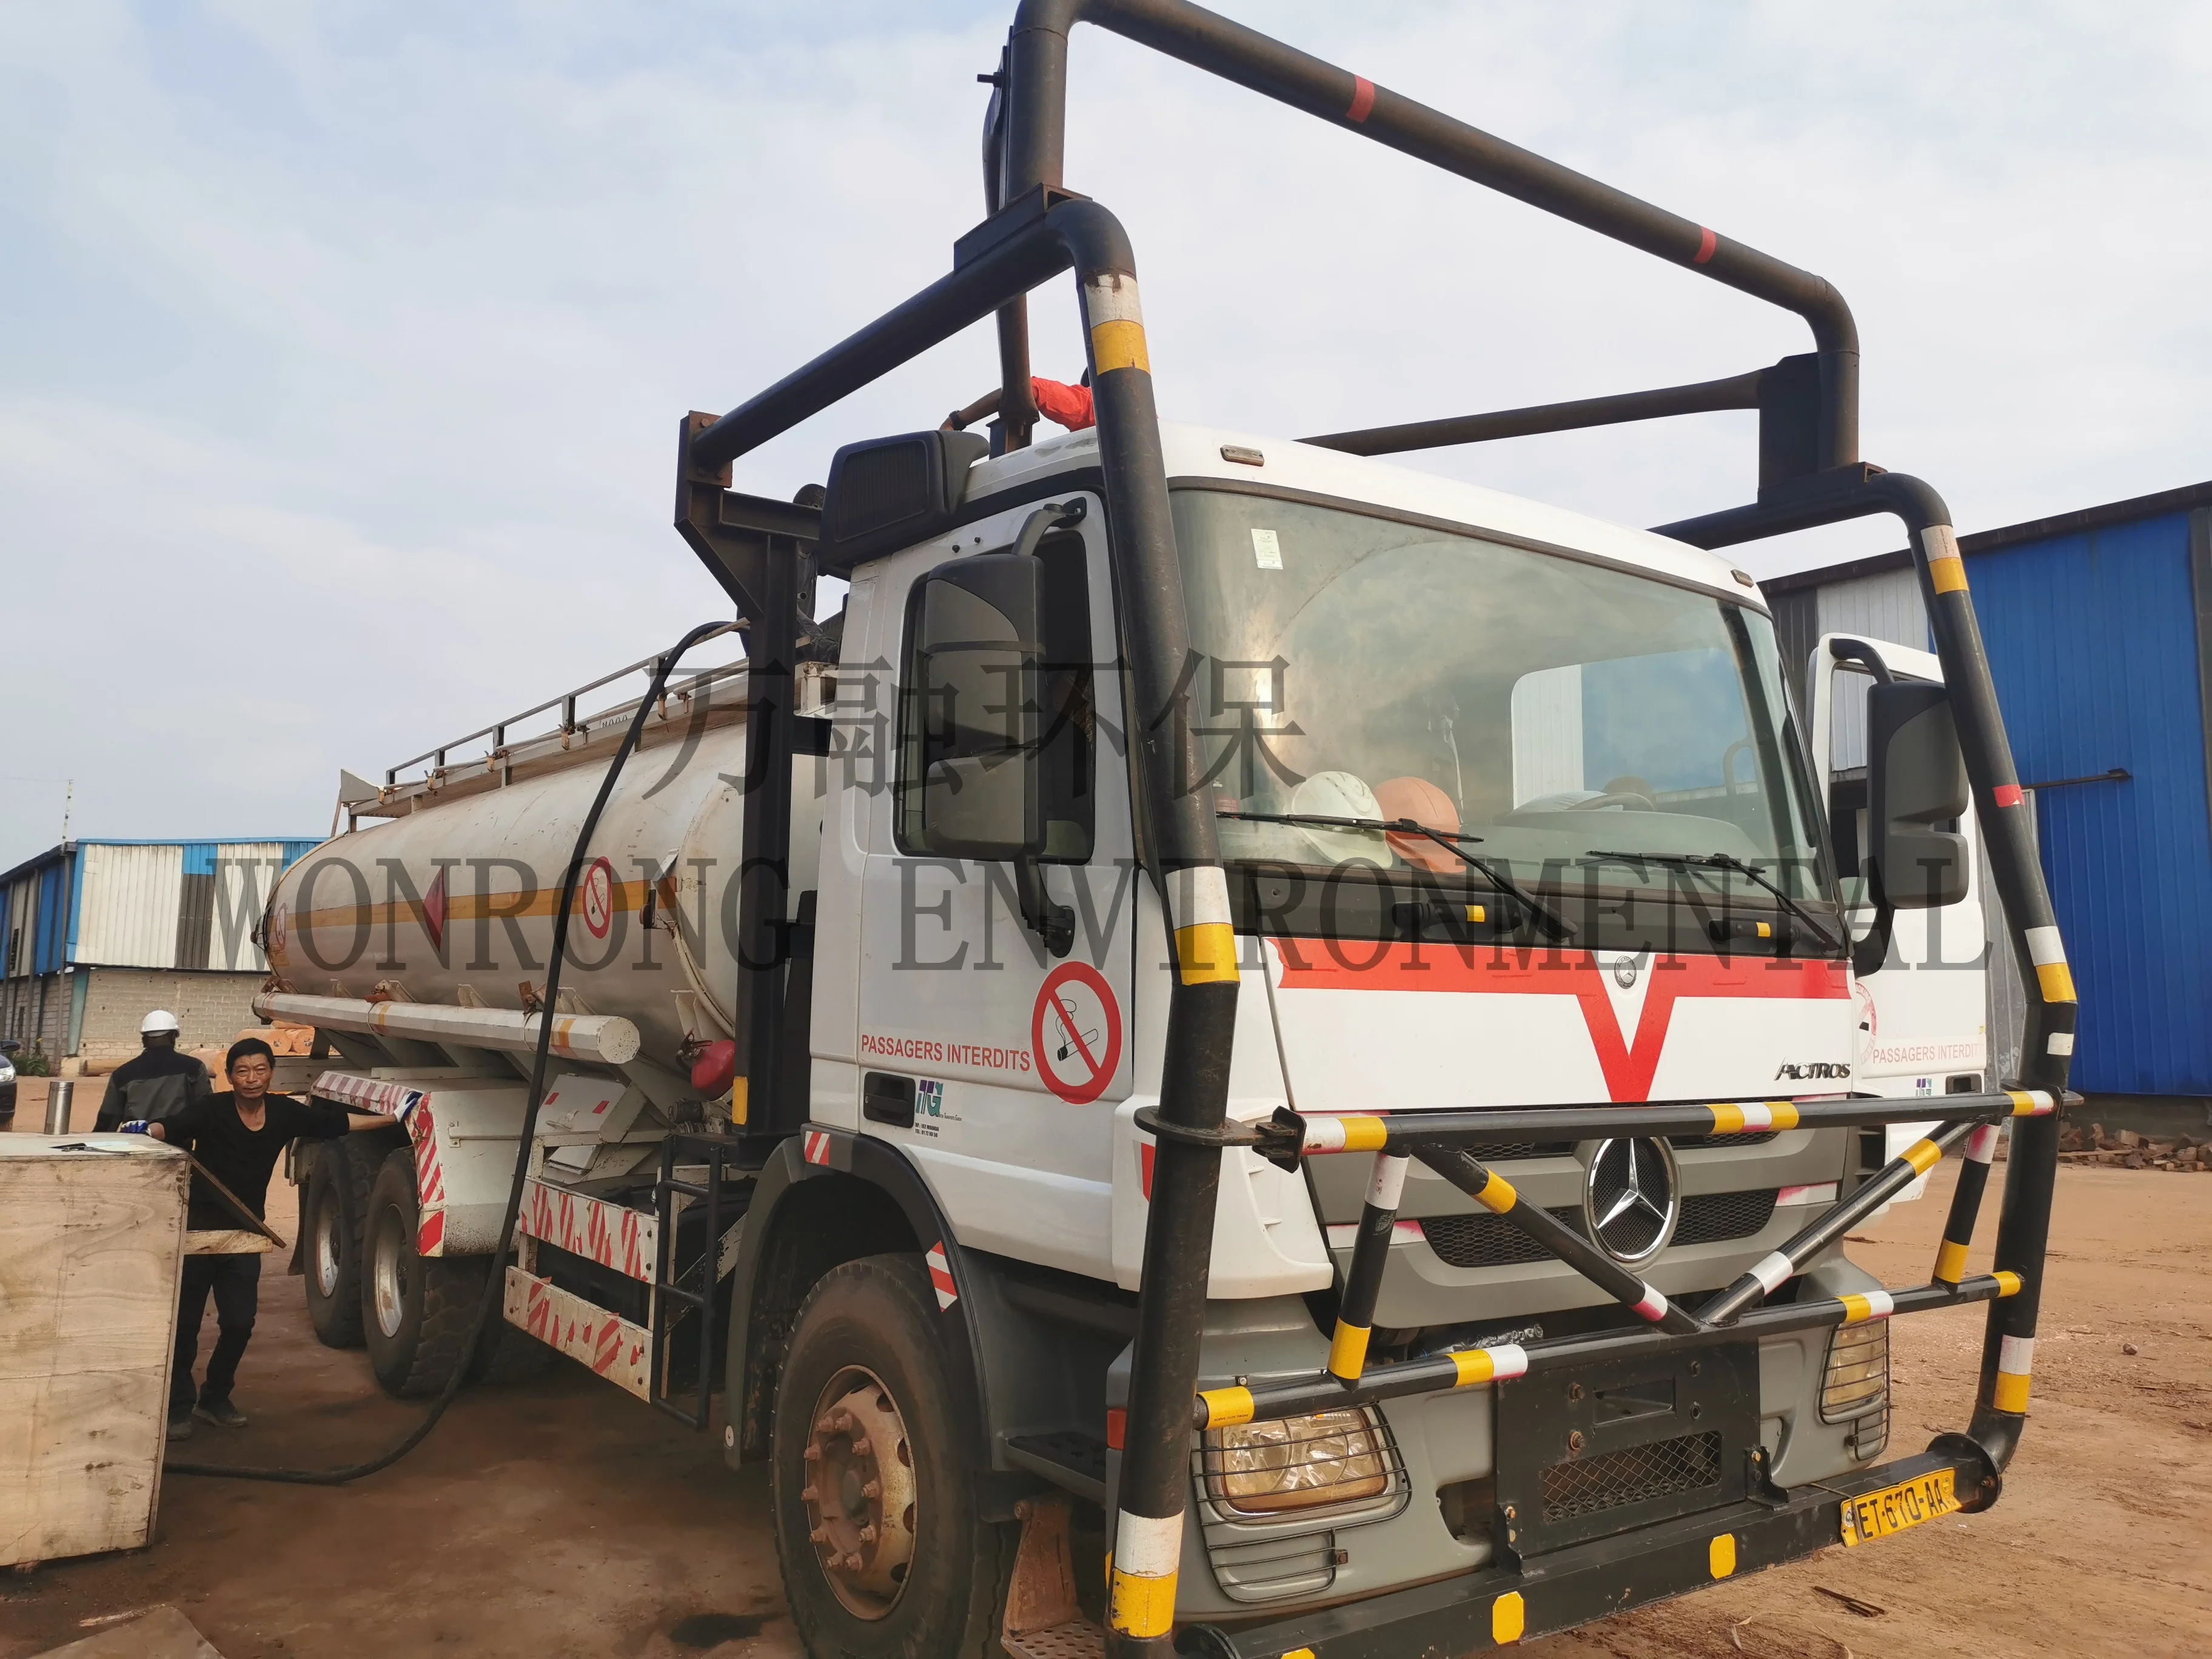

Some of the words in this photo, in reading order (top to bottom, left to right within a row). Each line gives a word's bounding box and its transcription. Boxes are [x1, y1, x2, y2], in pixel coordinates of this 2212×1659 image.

[862, 1034, 942, 1061] PASSAGERS
[947, 1044, 1030, 1071] INTERDITS
[1872, 1045, 1936, 1064] PASSAGERS
[1938, 1042, 1984, 1060] INTERDIT
[1774, 1056, 1851, 1081] ACTROS
